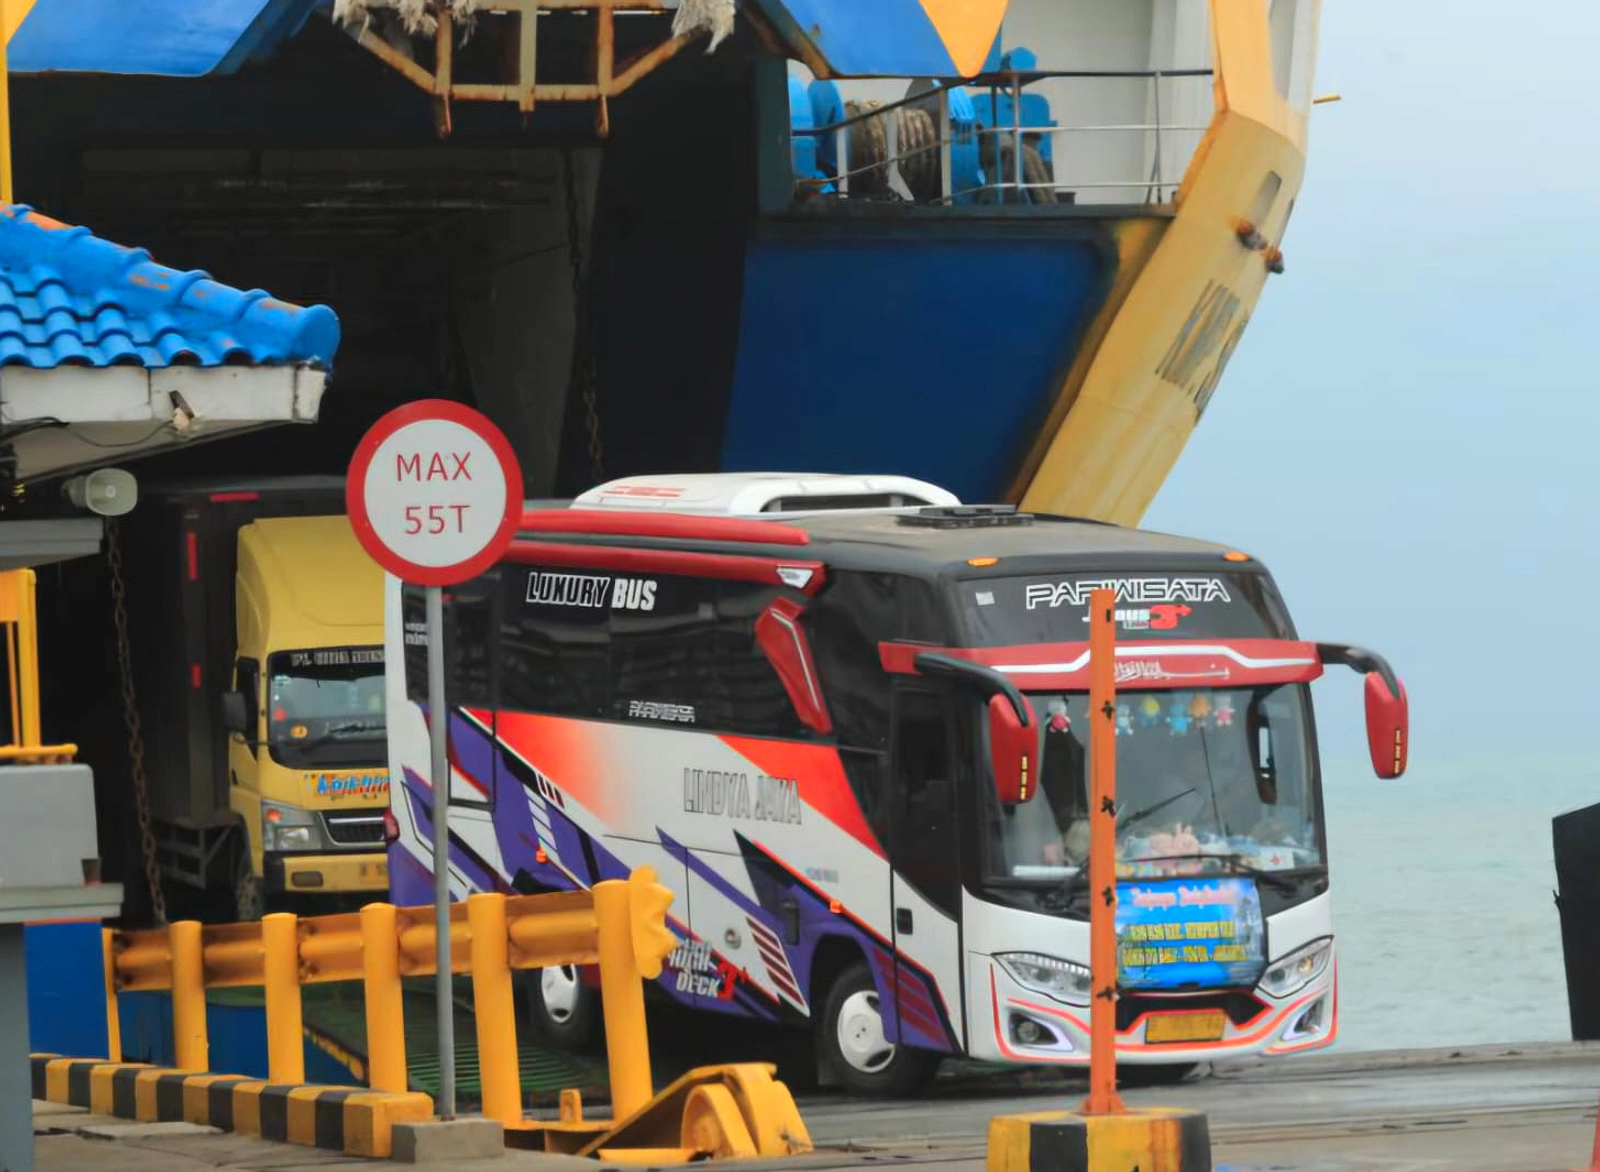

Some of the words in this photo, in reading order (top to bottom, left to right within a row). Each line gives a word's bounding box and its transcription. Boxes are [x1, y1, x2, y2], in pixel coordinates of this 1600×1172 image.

[396, 451, 472, 482] MAX
[404, 504, 471, 535] 55T
[525, 571, 611, 608] LUXURY
[610, 578, 658, 611] BUS
